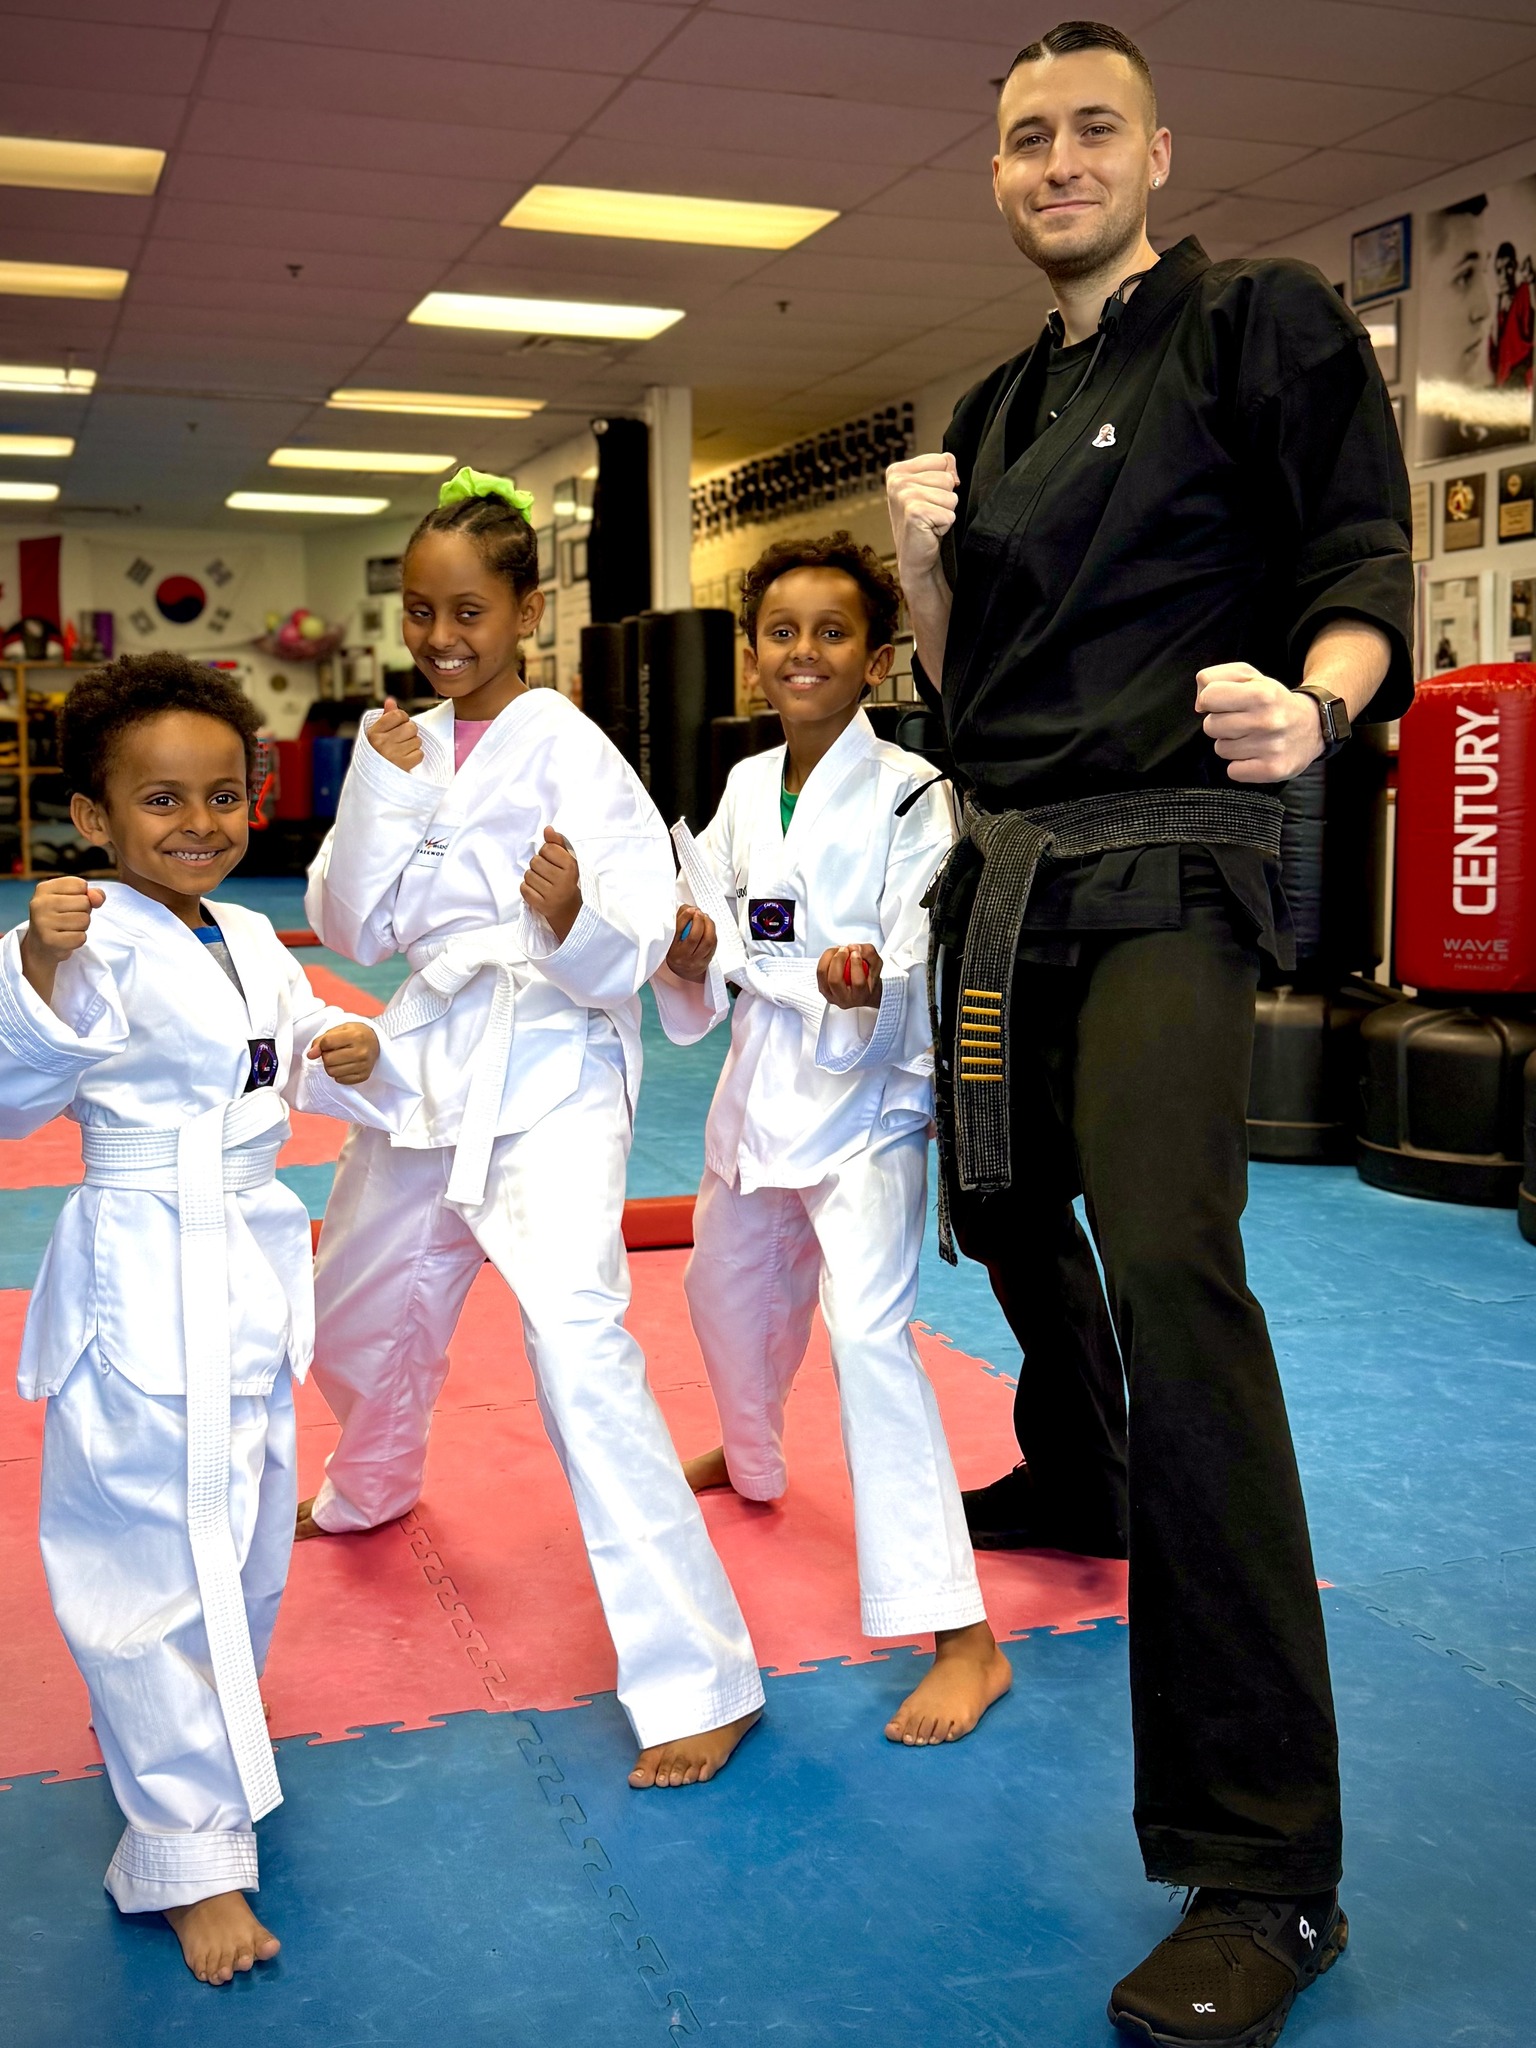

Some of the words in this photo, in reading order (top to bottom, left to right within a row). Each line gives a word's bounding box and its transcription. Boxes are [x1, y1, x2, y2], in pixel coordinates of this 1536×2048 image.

[1452, 705, 1500, 915] CENTURY
[1443, 938, 1509, 952] WAVE
[1443, 953, 1508, 961] MASTER
